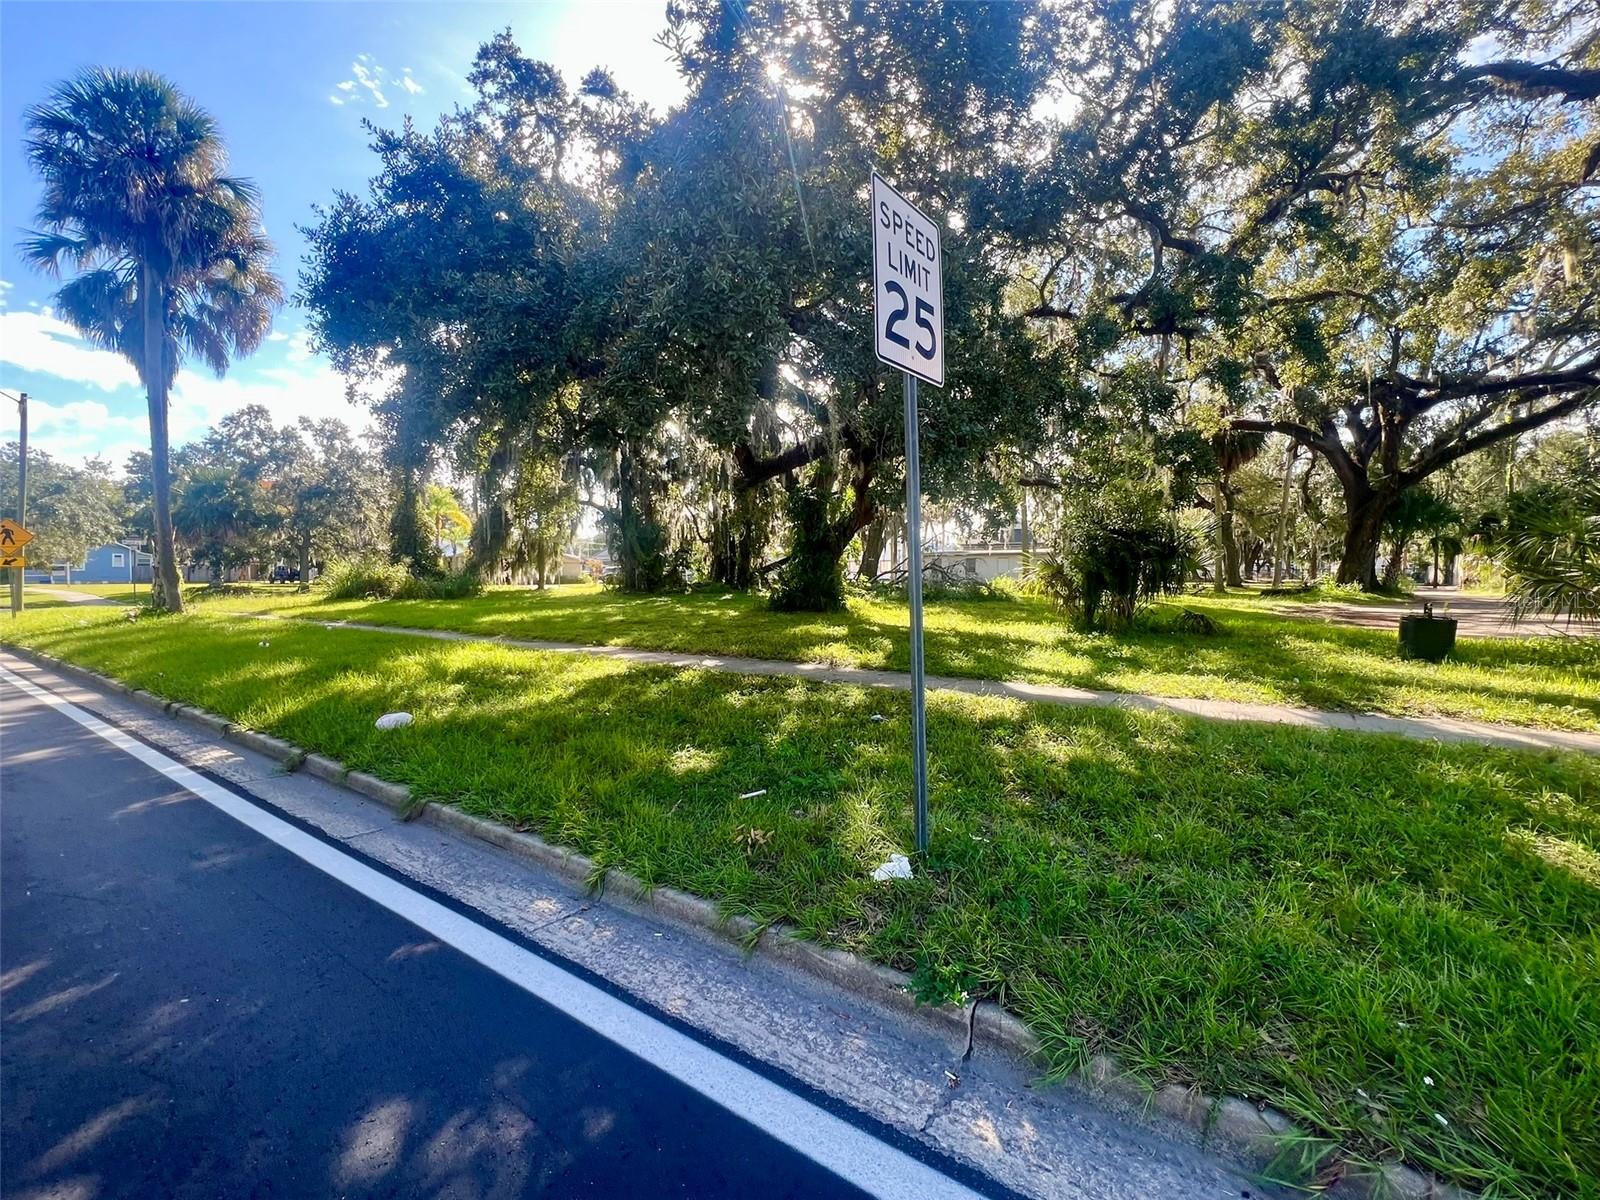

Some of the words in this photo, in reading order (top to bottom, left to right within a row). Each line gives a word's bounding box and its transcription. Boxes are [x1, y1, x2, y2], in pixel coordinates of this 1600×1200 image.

[880, 201, 935, 263] SPEED
[887, 242, 931, 292] LIMIT
[884, 280, 936, 360] 25
